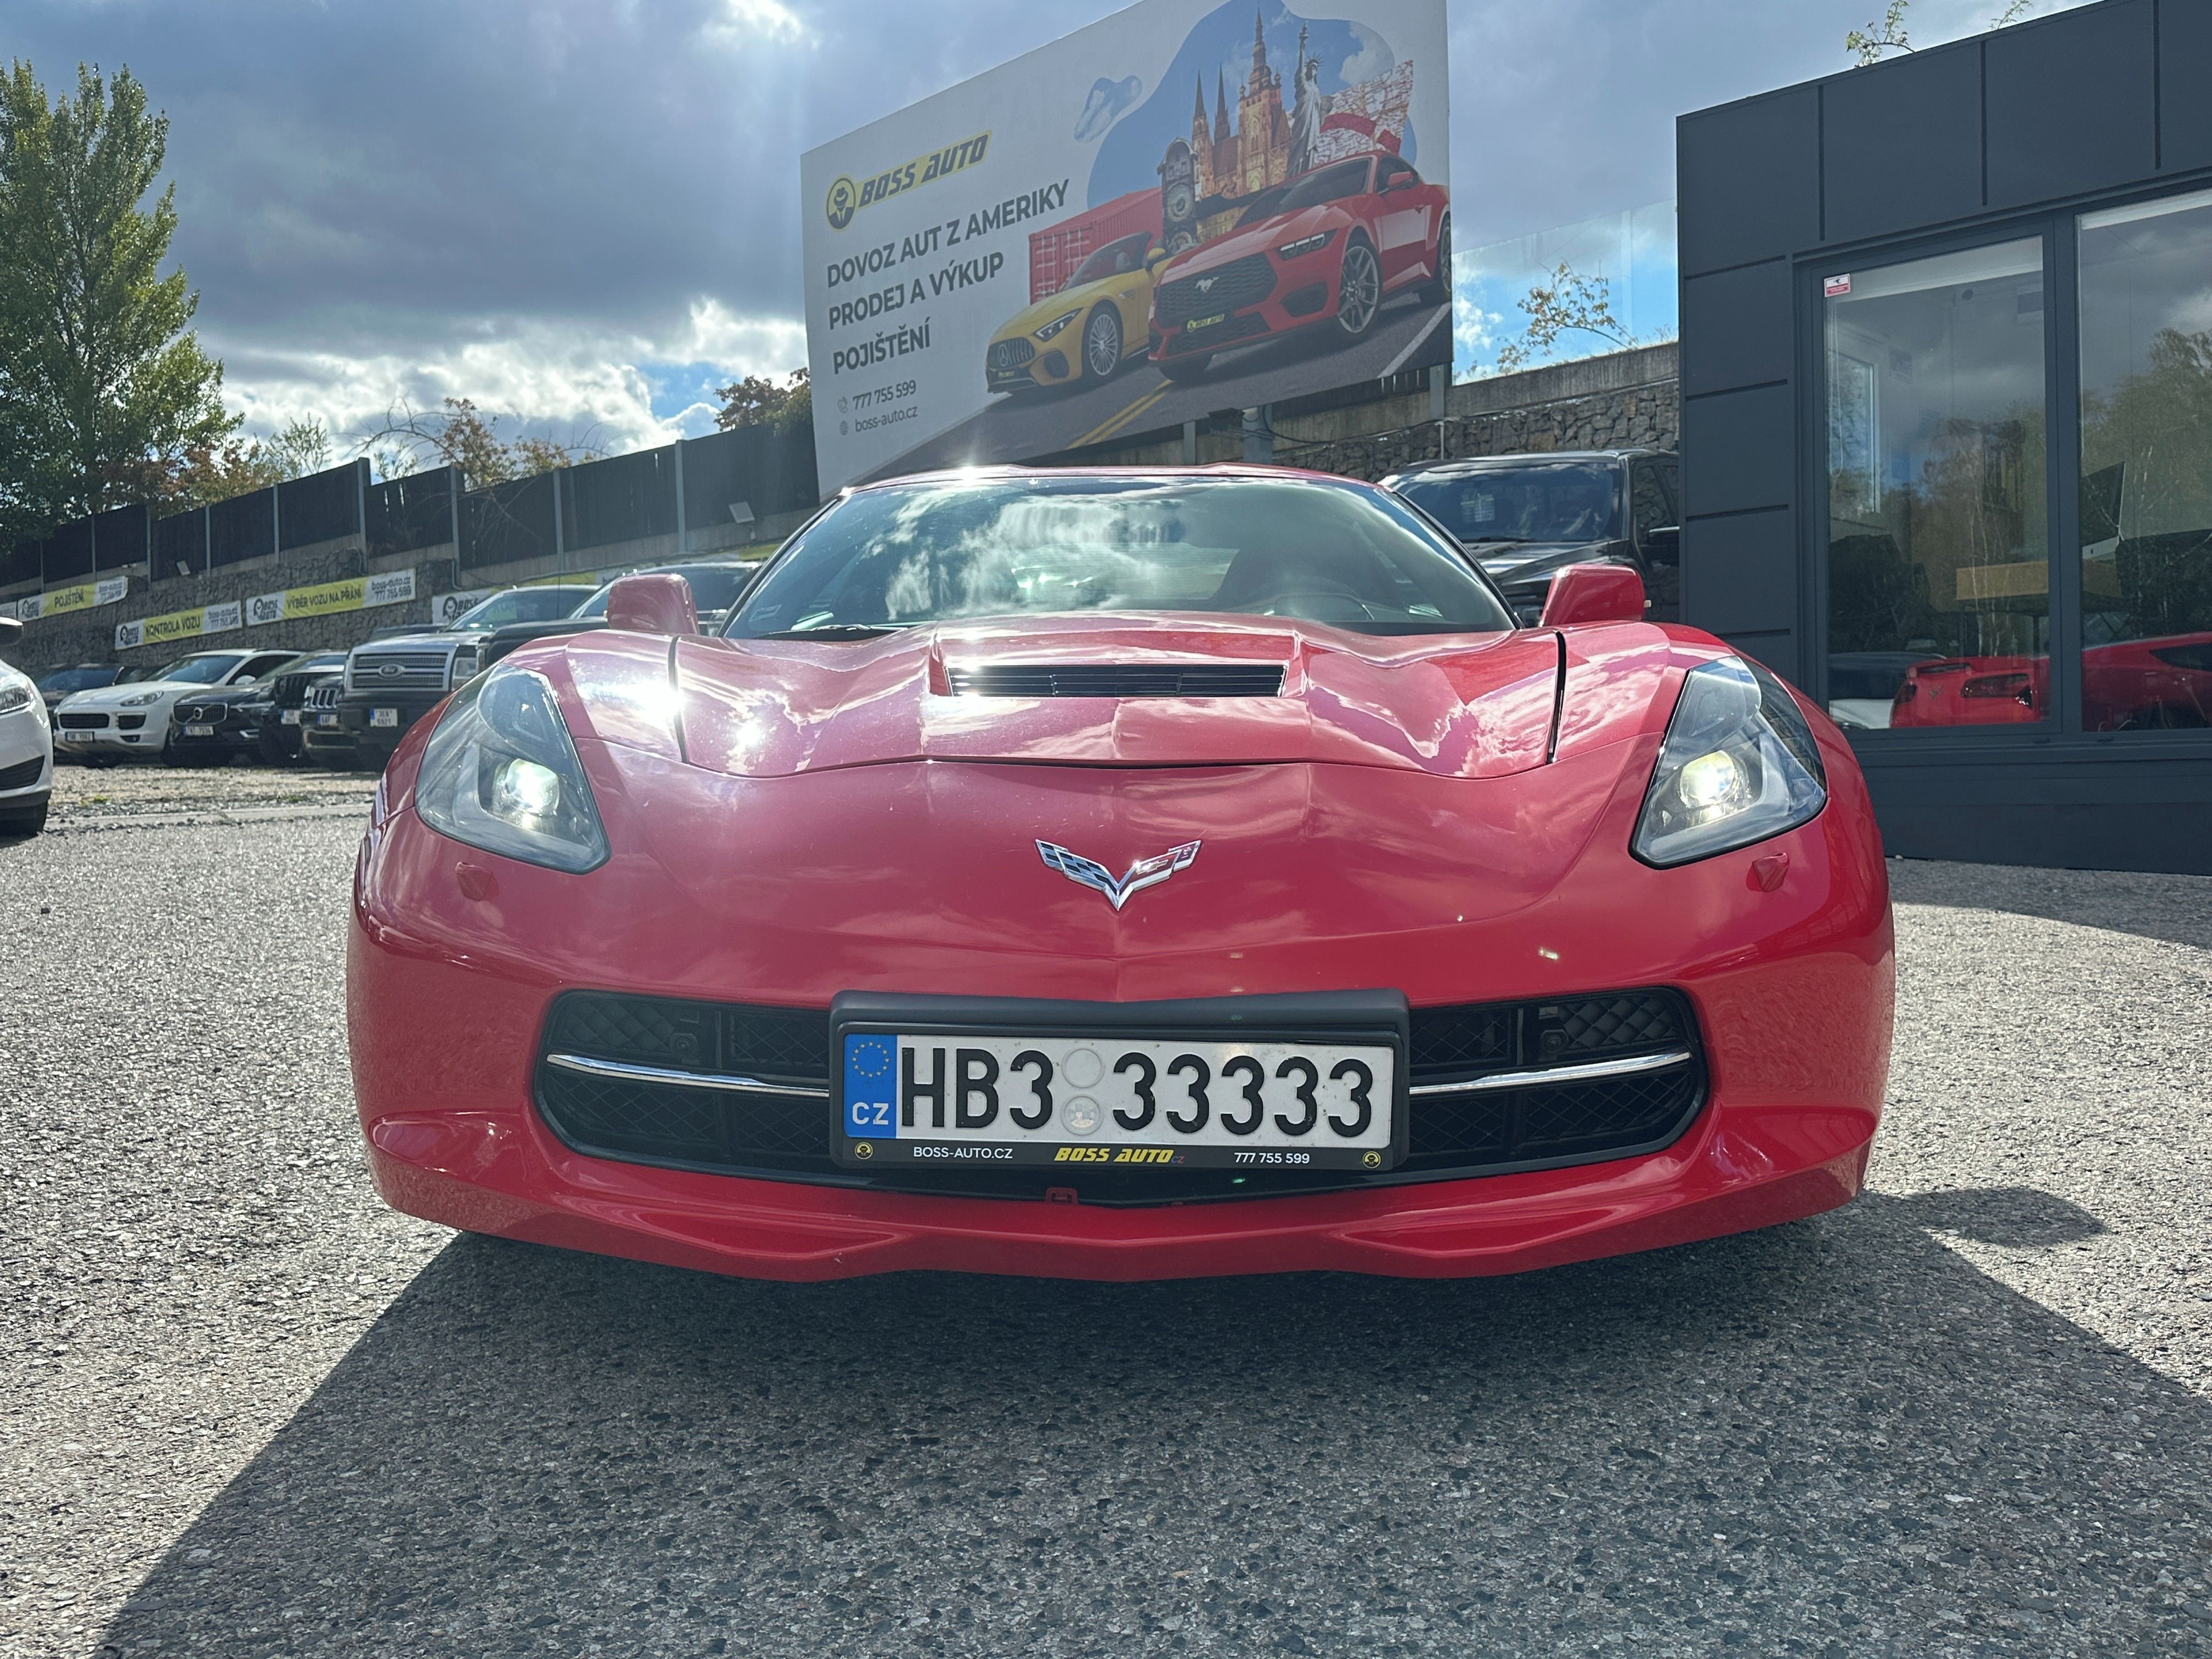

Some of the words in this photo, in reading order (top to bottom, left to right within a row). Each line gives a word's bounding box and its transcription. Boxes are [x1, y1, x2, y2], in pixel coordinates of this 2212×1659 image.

[859, 162, 917, 207] BOSS
[921, 134, 988, 183] AUTO
[827, 242, 895, 288] DOVOZ
[900, 225, 941, 263] AUT
[947, 219, 961, 246] Z
[965, 178, 1069, 240] AMERIKY
[829, 284, 905, 330] PRODEJ
[910, 279, 926, 304] A
[929, 252, 1003, 296] VÝKUP
[833, 317, 930, 375] POJIŠTĚNÍ
[853, 392, 872, 410] 777
[874, 386, 894, 404] 755
[896, 380, 917, 398] 599
[855, 406, 918, 432] boss-auto.cz
[286, 594, 308, 610] VÝBĚR
[309, 593, 328, 606] VOZU
[329, 592, 340, 603] NA
[341, 585, 362, 601] PŘÁNÍ
[375, 590, 386, 601] 777
[145, 619, 180, 636] KONTROLA
[181, 615, 200, 630] VOZU
[902, 1047, 1053, 1130] HB3
[1113, 1052, 1373, 1138] 33333
[852, 1102, 889, 1125] CZ
[913, 1147, 1013, 1159] BOSS-AUTO.CZ
[1054, 1147, 1110, 1161] BOSS
[1113, 1148, 1174, 1163] AUTO
[1234, 1152, 1256, 1163] 777
[1259, 1153, 1282, 1164] 755
[1285, 1153, 1310, 1164] 599
